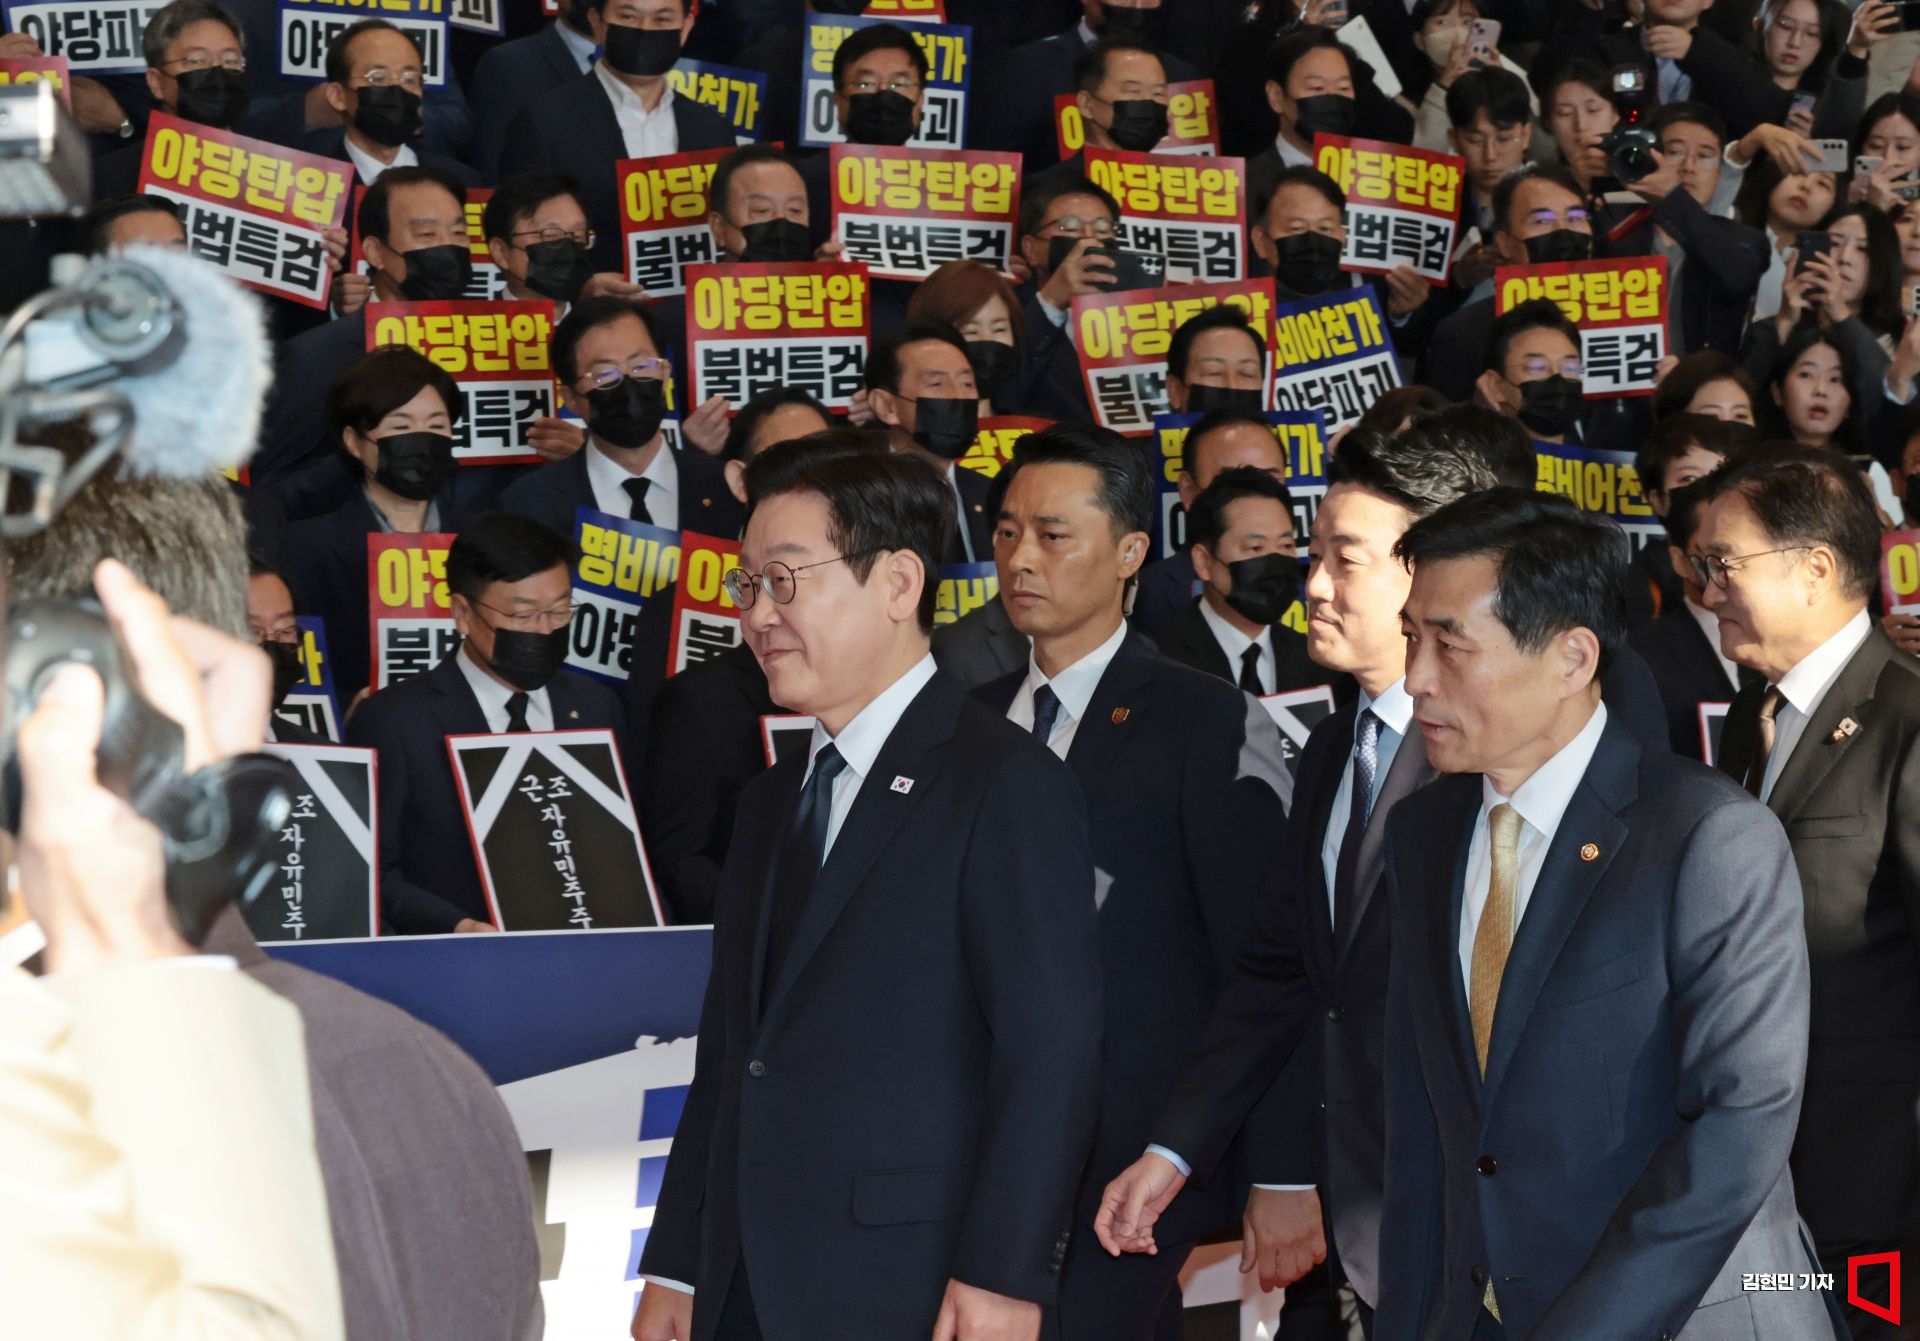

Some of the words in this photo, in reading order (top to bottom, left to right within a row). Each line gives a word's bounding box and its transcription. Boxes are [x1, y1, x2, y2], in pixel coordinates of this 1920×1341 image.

[20, 9, 163, 62] 야당파
[151, 128, 345, 225] 야당탄압
[625, 163, 718, 222] 야당
[838, 156, 1016, 214] 야당탄압
[1090, 159, 1240, 216] 야당탄압
[1318, 145, 1460, 212] 야당탄압
[178, 203, 321, 291] 법특검
[1342, 210, 1449, 273] 법특검
[694, 274, 865, 331] 야당탄압
[1276, 298, 1385, 370] 비어천가
[1586, 333, 1659, 384] 특검
[703, 345, 864, 401] 불법특검
[452, 389, 549, 438] 특검
[291, 794, 317, 818] 조
[518, 774, 573, 802] 근조
